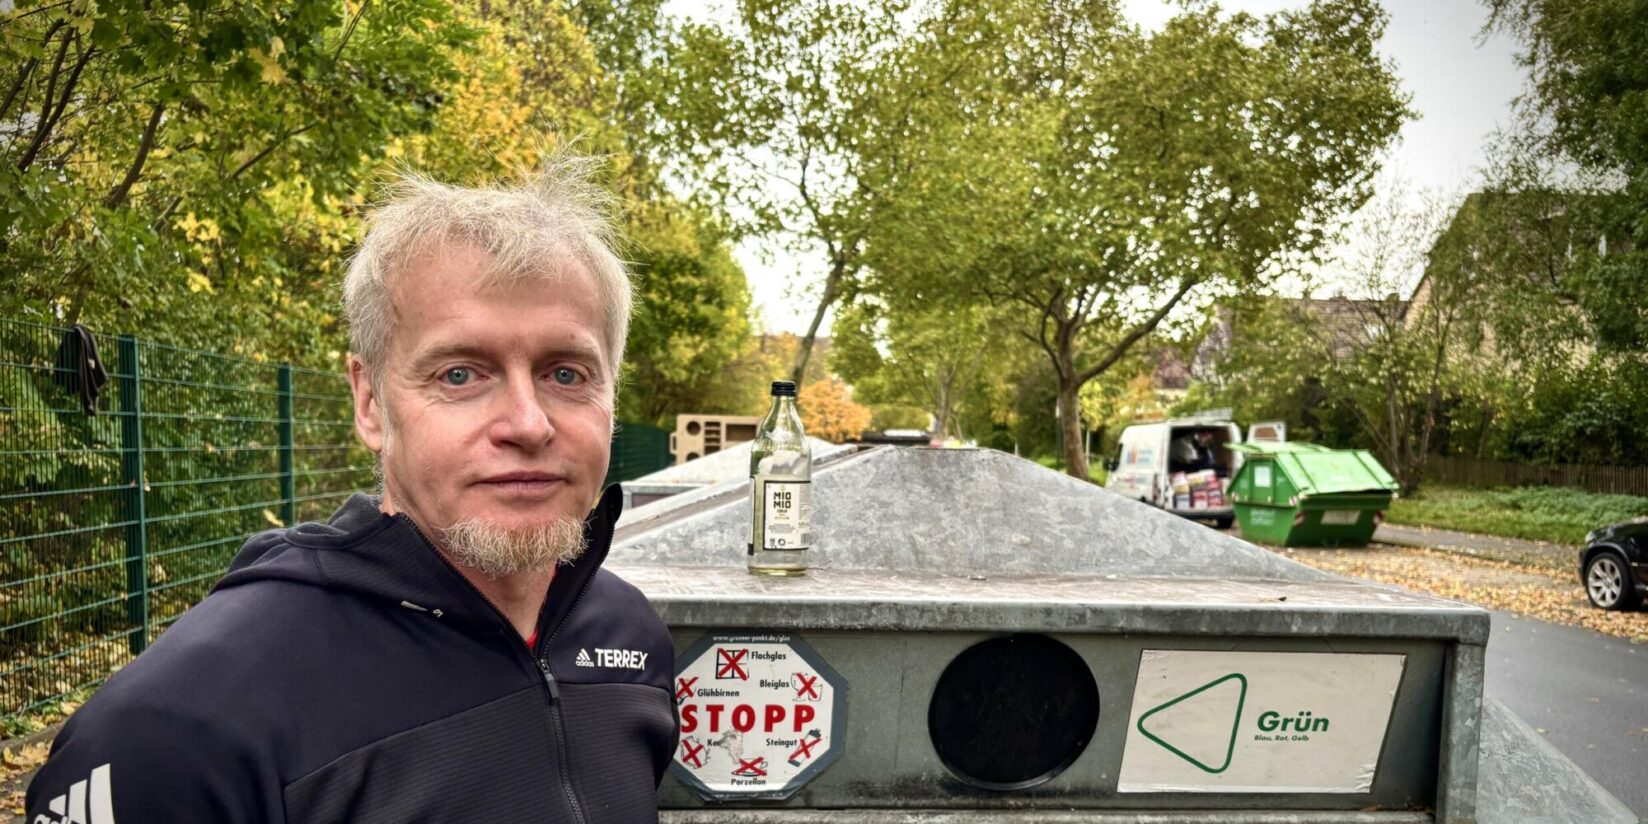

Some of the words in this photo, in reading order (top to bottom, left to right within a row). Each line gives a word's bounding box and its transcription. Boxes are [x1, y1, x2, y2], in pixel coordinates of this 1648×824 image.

[773, 492, 791, 500] MIO
[773, 501, 791, 509] MIO
[594, 648, 648, 671] TERREX
[751, 651, 786, 661] Flachglas
[575, 660, 595, 668] adidas
[759, 679, 790, 690] Bleiglas
[697, 688, 740, 697] Glühbirnen
[681, 704, 815, 733] STOPP
[1257, 710, 1330, 732] Grün
[766, 738, 797, 747] Steingut
[731, 778, 766, 786] Porzellan
